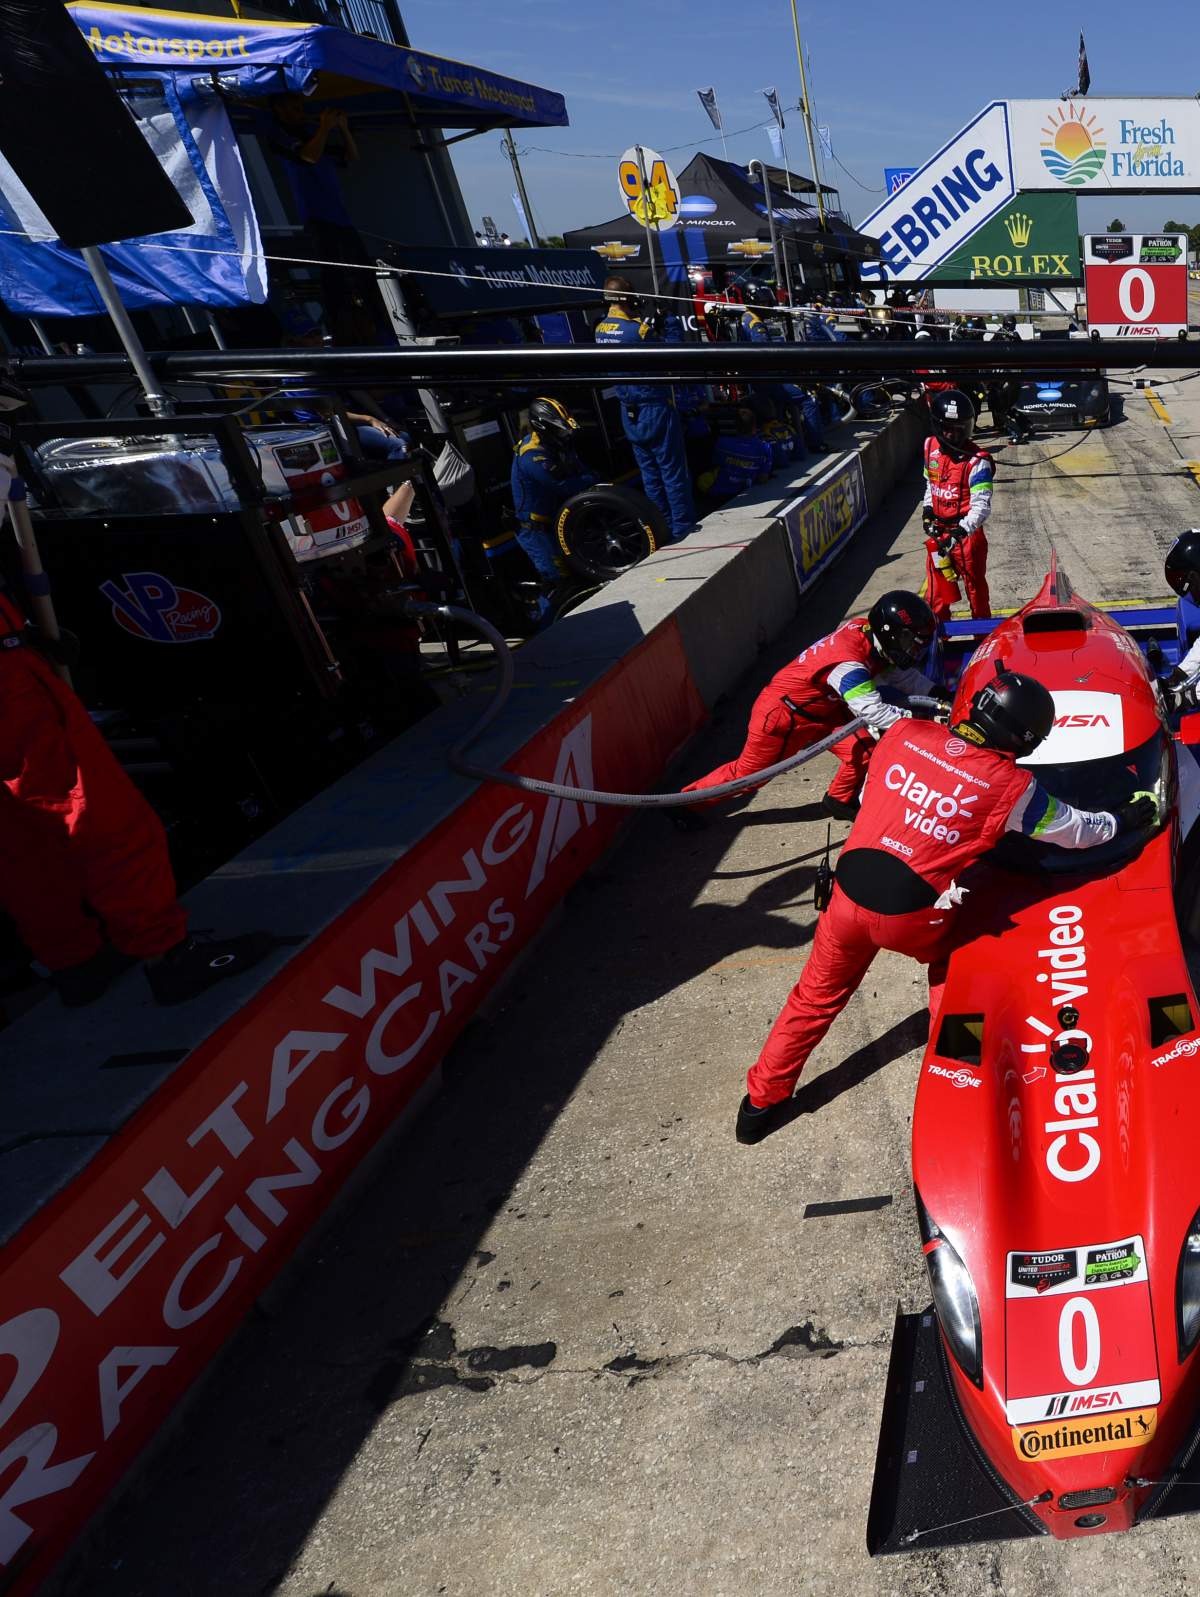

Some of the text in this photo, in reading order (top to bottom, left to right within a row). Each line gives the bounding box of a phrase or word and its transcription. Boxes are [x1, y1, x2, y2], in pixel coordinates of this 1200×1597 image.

[1119, 118, 1176, 144] Fresh
[1111, 151, 1185, 177] Florida
[861, 148, 1004, 281] SEBRING
[475, 264, 596, 289] Turner Motorsport
[971, 254, 1072, 277] ROLEX
[1118, 267, 1156, 322] 0
[1130, 327, 1160, 335] IMSA
[1052, 714, 1110, 728] MSA
[903, 740, 991, 789] www.deltawingracing.com
[884, 763, 958, 818] Claro
[904, 807, 961, 845] video
[1038, 905, 1088, 1007] video
[365, 898, 515, 1076] CARS
[927, 1064, 982, 1088] TRACFONE
[1031, 1253, 1065, 1264] TUDOR
[1095, 1249, 1127, 1262] PATRÓN
[1058, 1296, 1101, 1386] 0
[1069, 1391, 1123, 1413] IMSA
[1019, 1418, 1132, 1459] Continental
